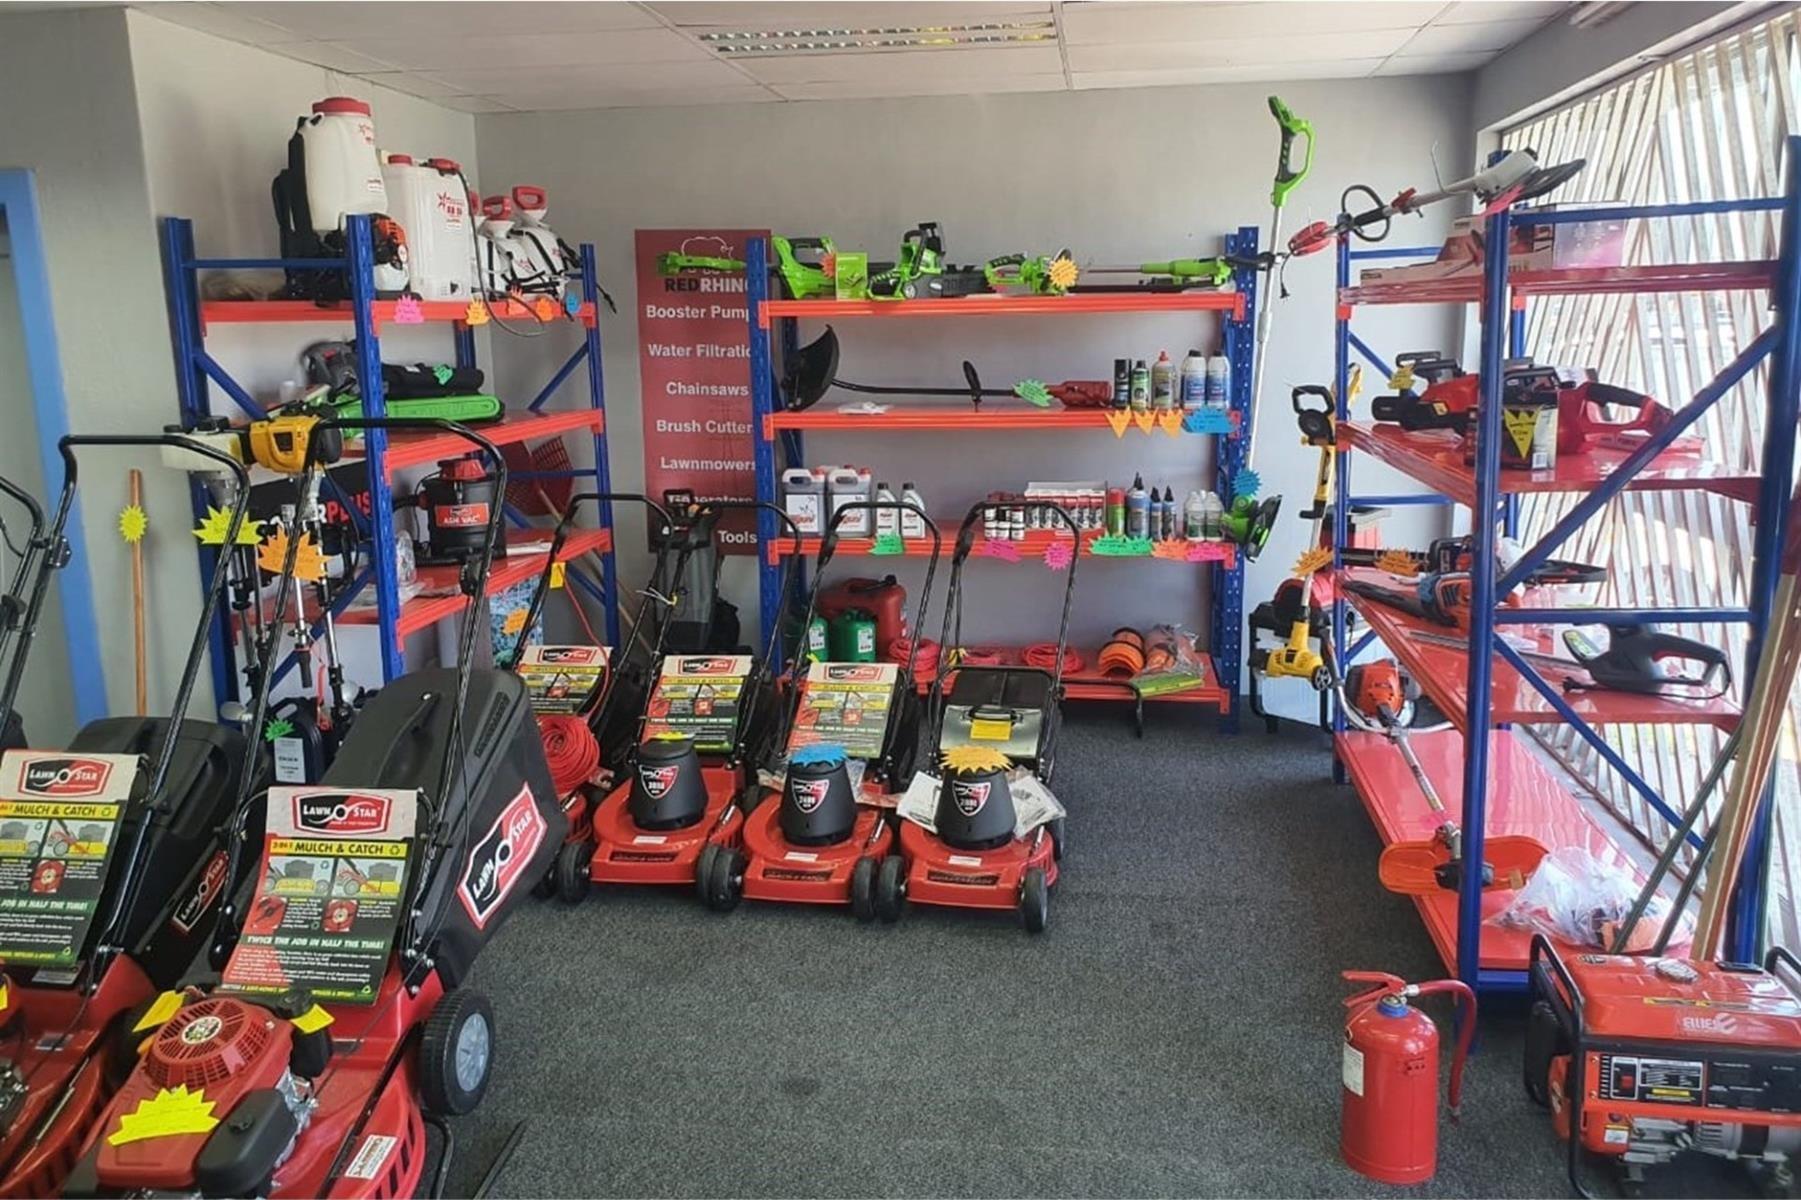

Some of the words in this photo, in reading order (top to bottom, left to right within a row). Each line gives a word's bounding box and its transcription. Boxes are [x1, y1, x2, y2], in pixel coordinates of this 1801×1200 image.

[665, 277, 749, 293] REDRHIN
[646, 304, 706, 319] Booster
[711, 305, 750, 322] Pum
[648, 343, 692, 357] Water
[666, 381, 749, 396] Chainsaws
[656, 419, 701, 433] Brush
[705, 420, 753, 433] Cutter
[717, 530, 758, 544] Tools
[29, 769, 57, 780] LAWN
[75, 769, 98, 781] STAR
[14, 803, 50, 815] MULCH
[63, 805, 96, 816] CATCH
[303, 805, 331, 815] LAWN
[353, 805, 377, 817] STAR
[295, 842, 333, 853] MULCH
[348, 844, 384, 855] CATCH
